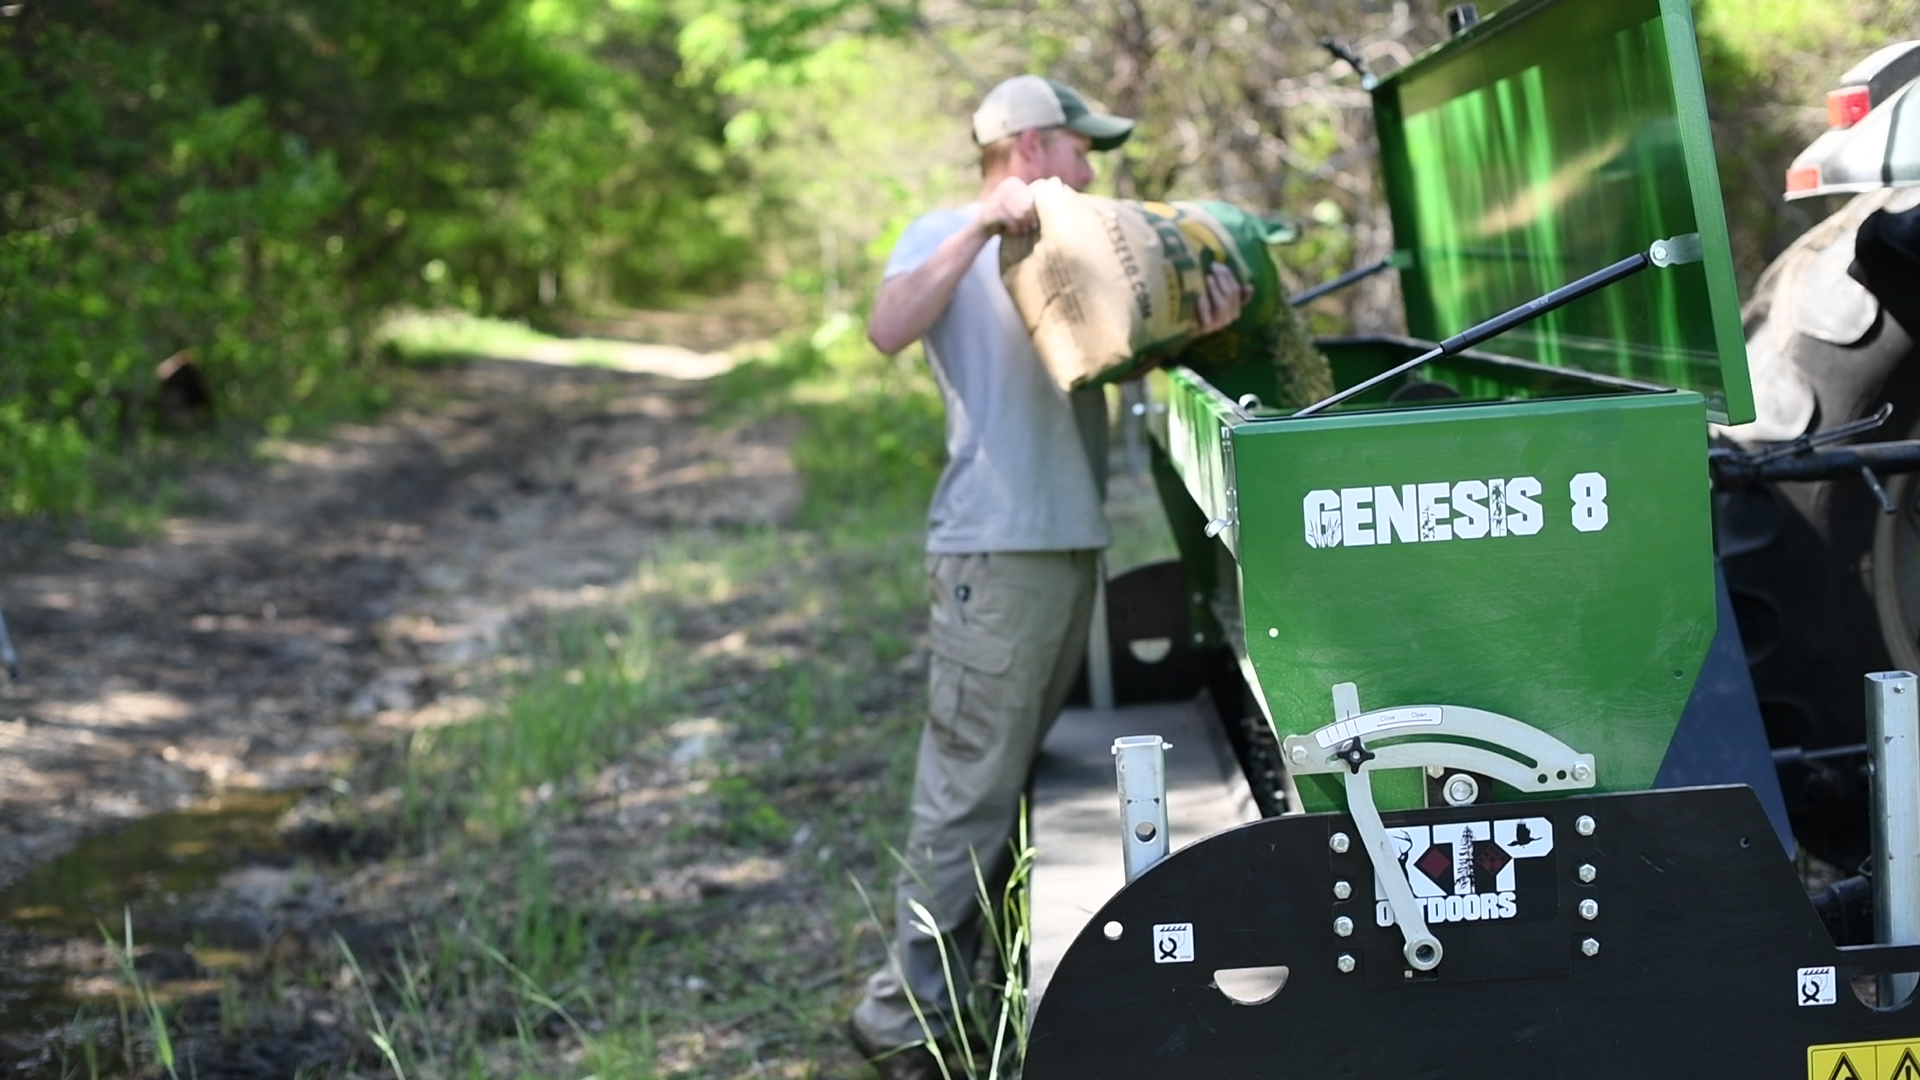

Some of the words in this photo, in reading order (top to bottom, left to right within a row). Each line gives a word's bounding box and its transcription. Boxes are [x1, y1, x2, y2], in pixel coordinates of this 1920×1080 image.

[1303, 476, 1544, 549] GENESIS
[1569, 472, 1609, 532] 8
[1411, 711, 1428, 719] Open
[1375, 891, 1517, 927] OTDOORS
